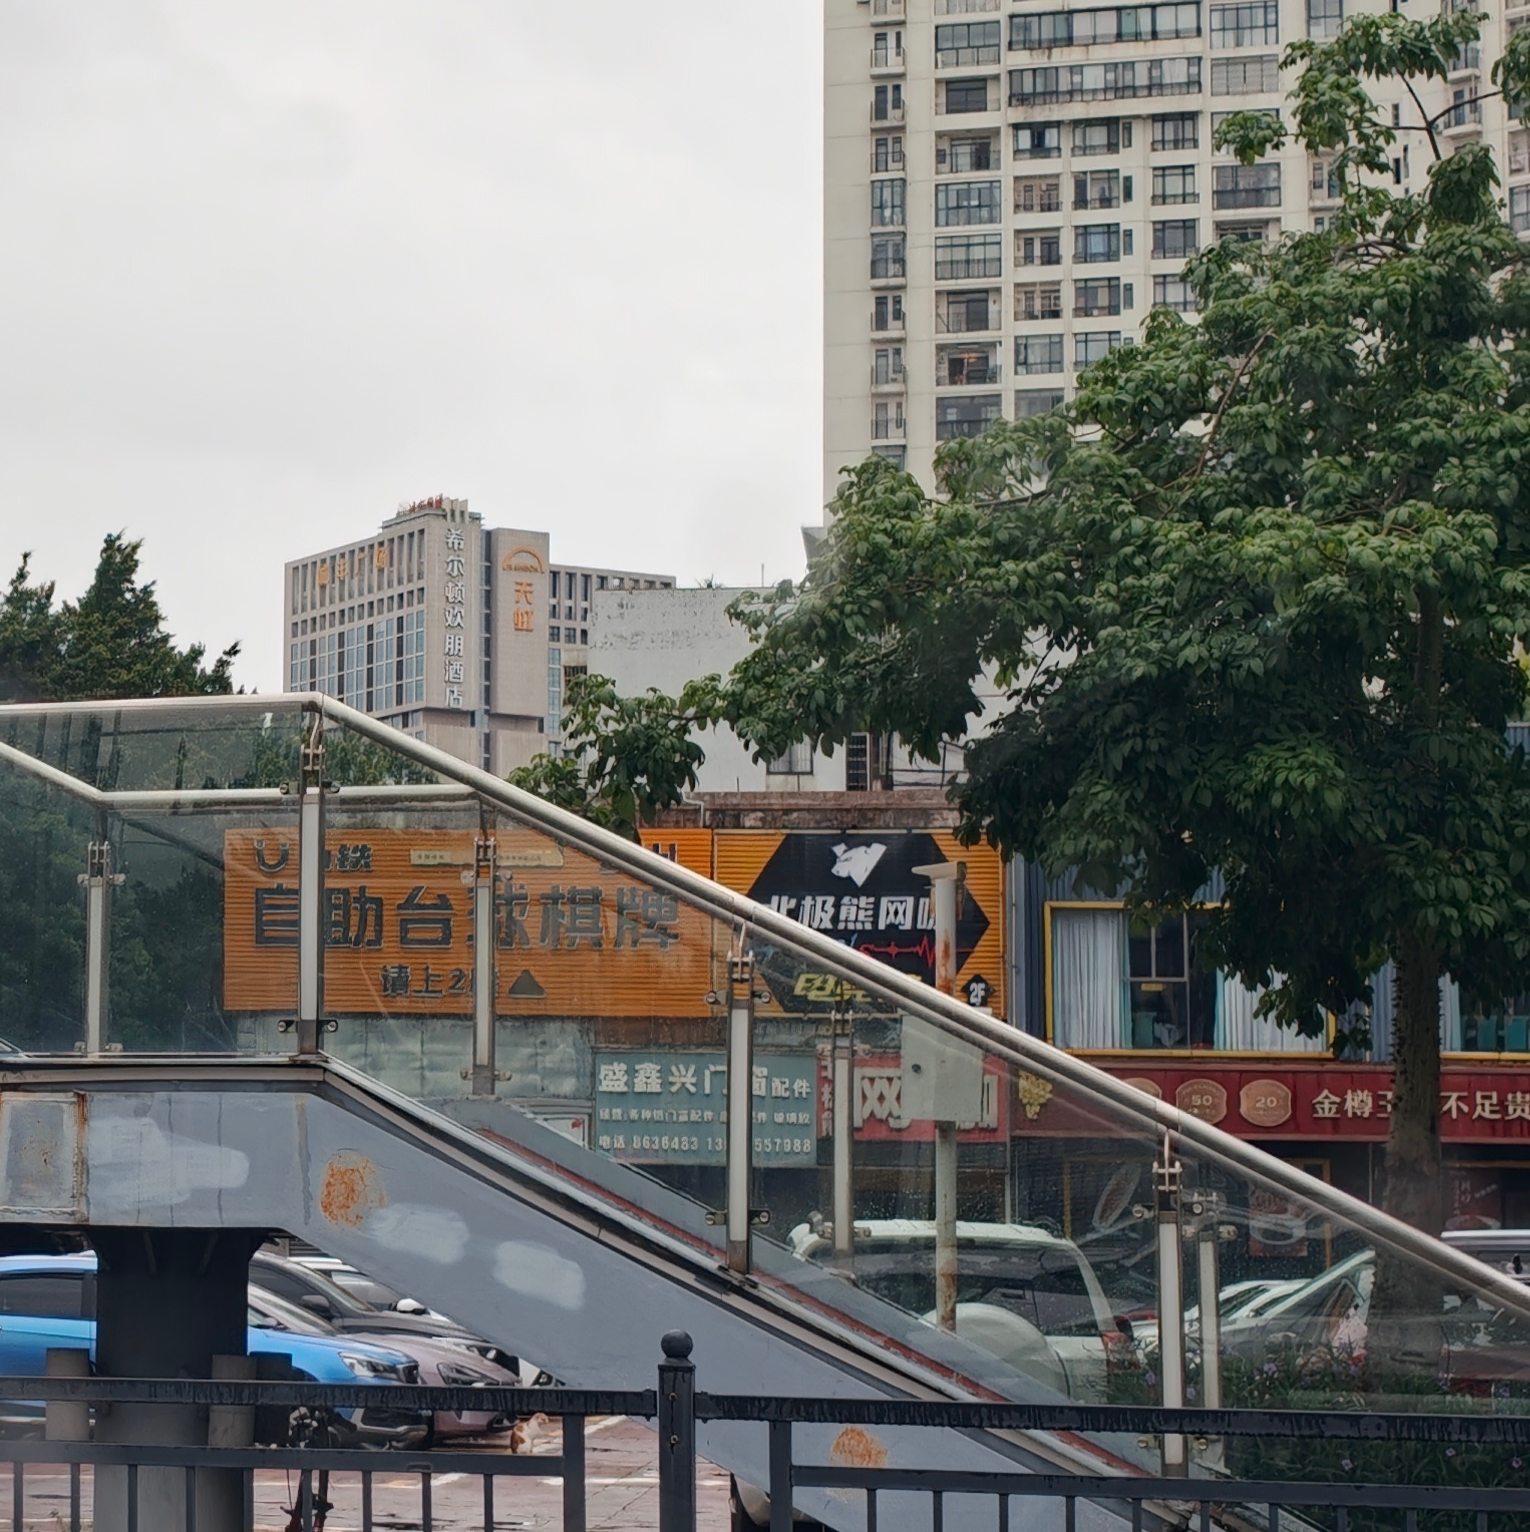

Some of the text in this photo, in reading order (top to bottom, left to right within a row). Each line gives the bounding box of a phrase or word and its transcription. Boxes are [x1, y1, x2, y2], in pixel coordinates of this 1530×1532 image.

[444, 526, 466, 710] 希尔顿欢朋酒店
[254, 883, 681, 949] 自助台球棋牌
[381, 963, 499, 996] 请上2
[970, 982, 987, 1006] 2F
[1192, 1095, 1213, 1108] 50
[1254, 1097, 1277, 1109] 20
[598, 1135, 625, 1150] 电话
[707, 1136, 812, 1154] 13557988
